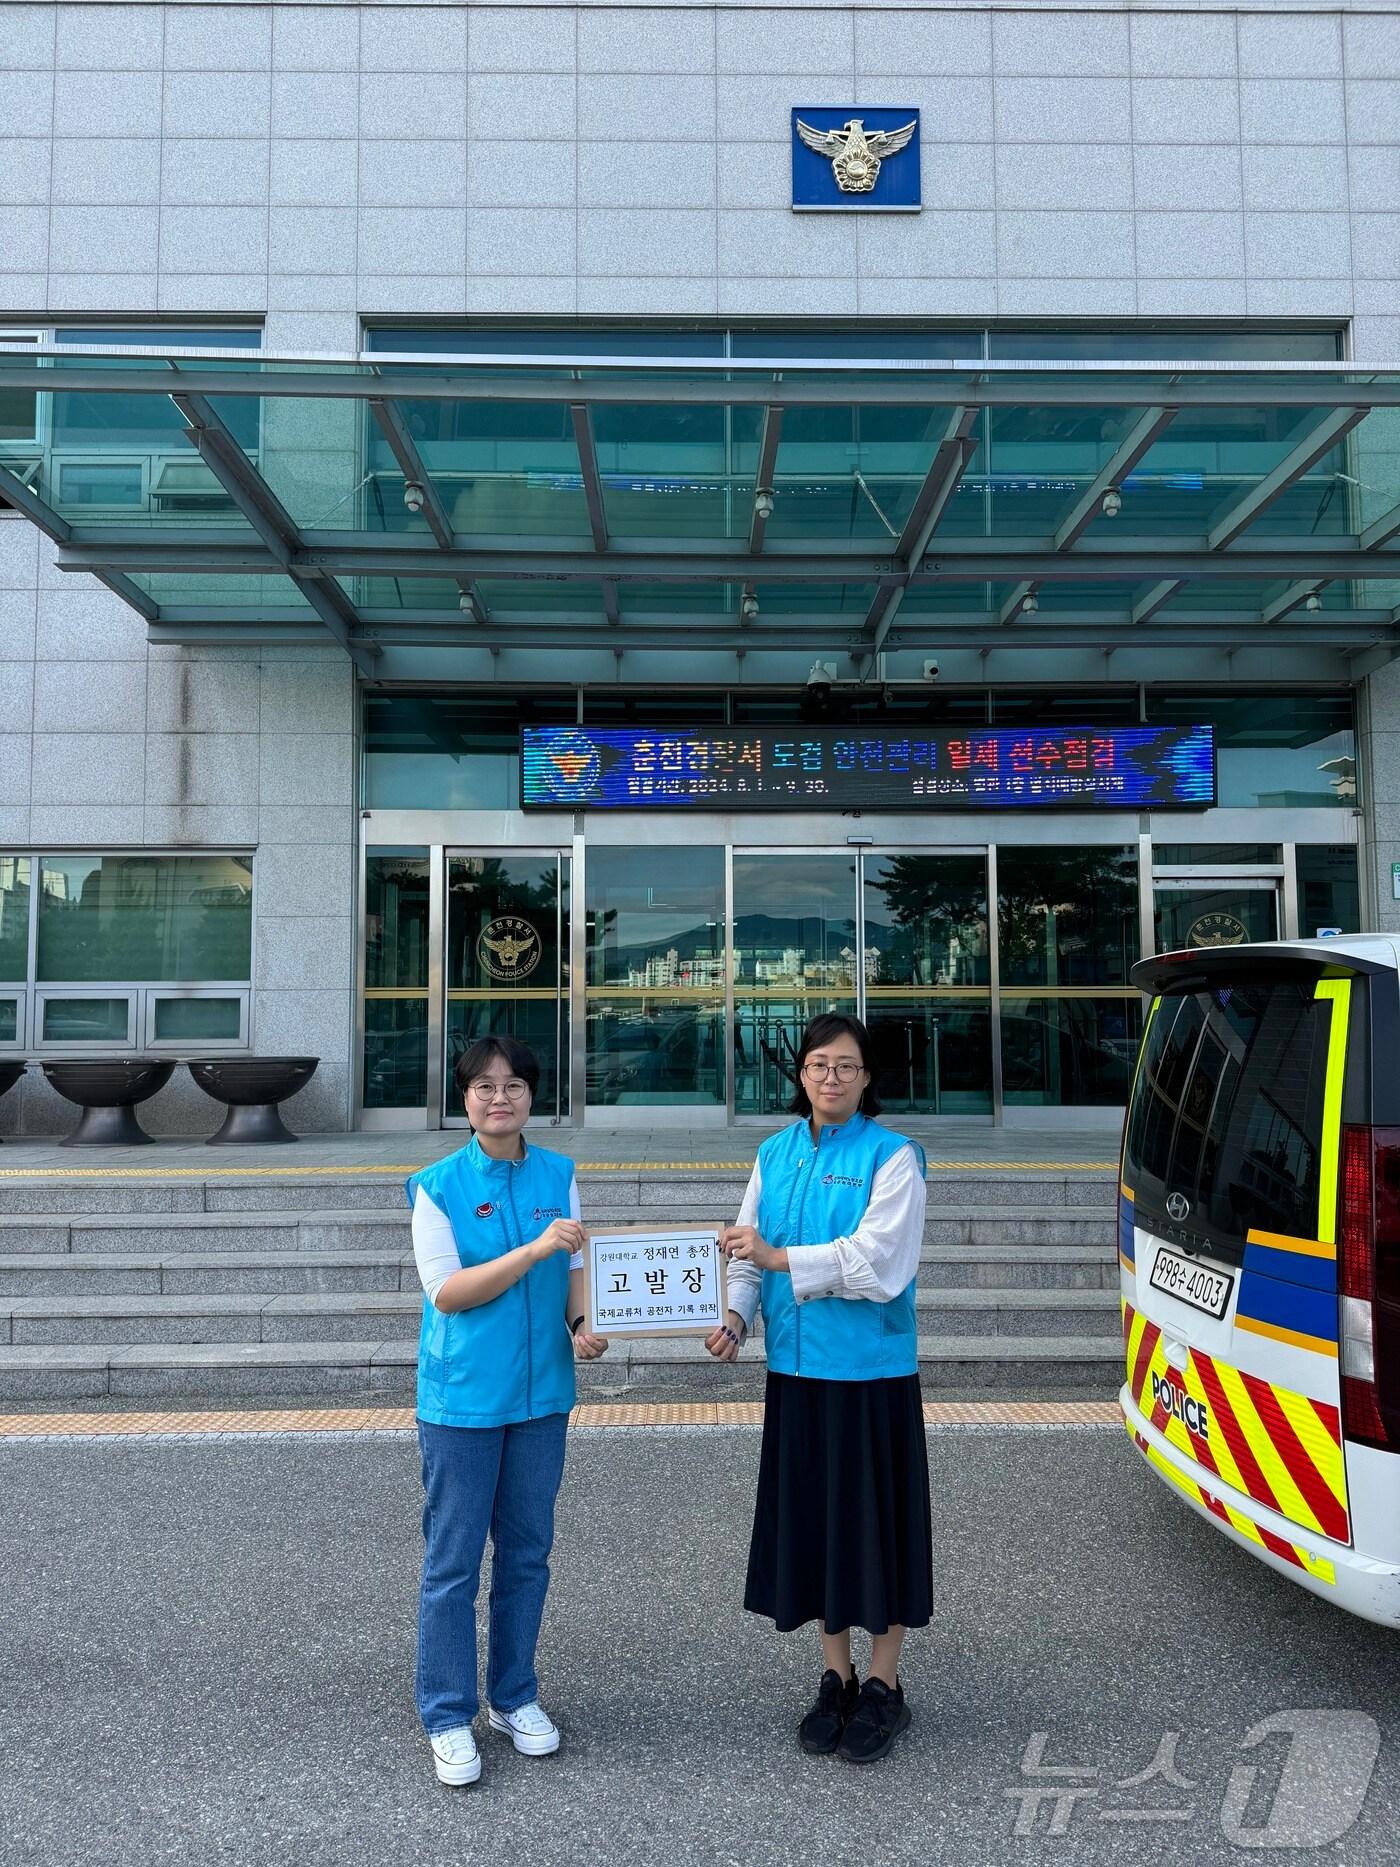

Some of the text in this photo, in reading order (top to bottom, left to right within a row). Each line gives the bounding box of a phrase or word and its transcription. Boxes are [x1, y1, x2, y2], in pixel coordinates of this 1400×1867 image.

[772, 743, 822, 770] 도검
[833, 740, 937, 772] 안전관리
[947, 739, 998, 771] 일제
[1147, 1218, 1213, 1250] STARIA
[600, 1244, 711, 1263] 강원대학교 정재연 총장
[607, 1266, 706, 1295] 고발장
[1157, 1256, 1224, 1309] 998수4003
[598, 1303, 717, 1319] 국제교류처 공전자 기록 위작
[1151, 1370, 1209, 1439] POLICE
